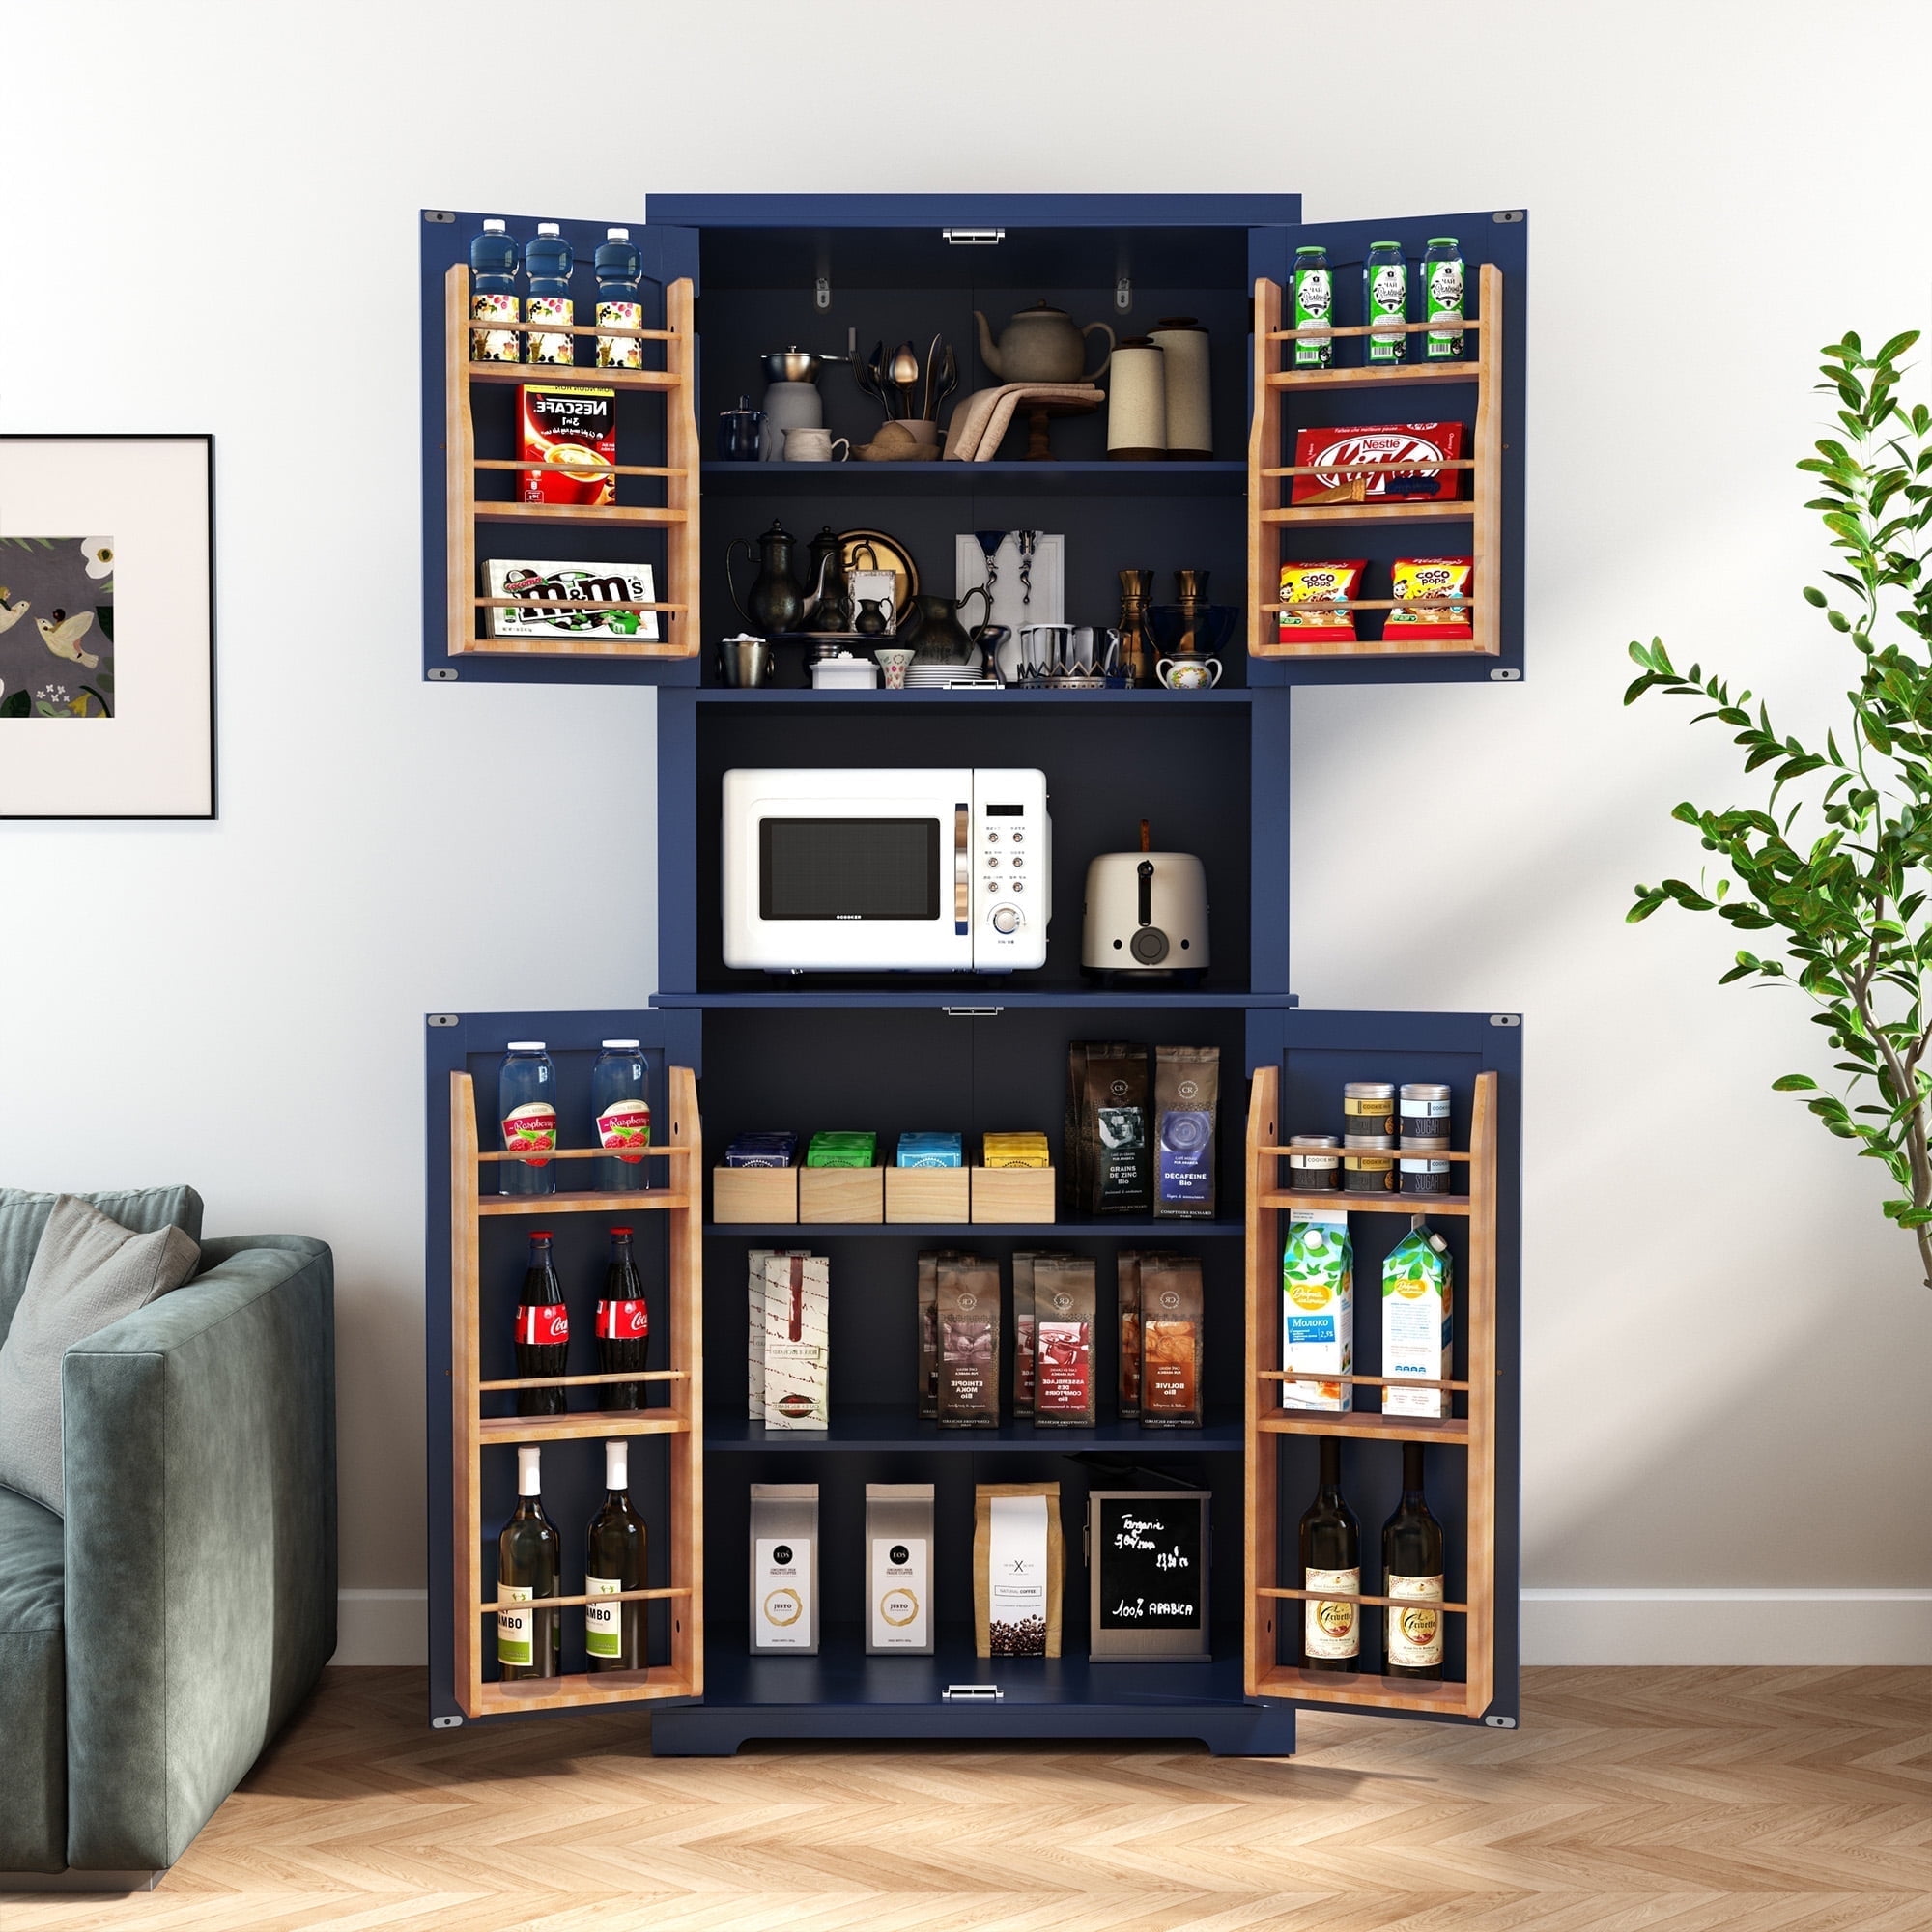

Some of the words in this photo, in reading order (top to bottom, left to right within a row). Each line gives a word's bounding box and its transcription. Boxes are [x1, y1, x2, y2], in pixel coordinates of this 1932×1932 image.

[514, 1119, 553, 1130] Raspberry
[610, 1116, 646, 1127] Raspberry
[1415, 1118, 1439, 1135] SUGAR
[1415, 1174, 1439, 1190] SUGAR
[1112, 1597, 1144, 1619] 100%
[1149, 1602, 1194, 1616] ARABICA
